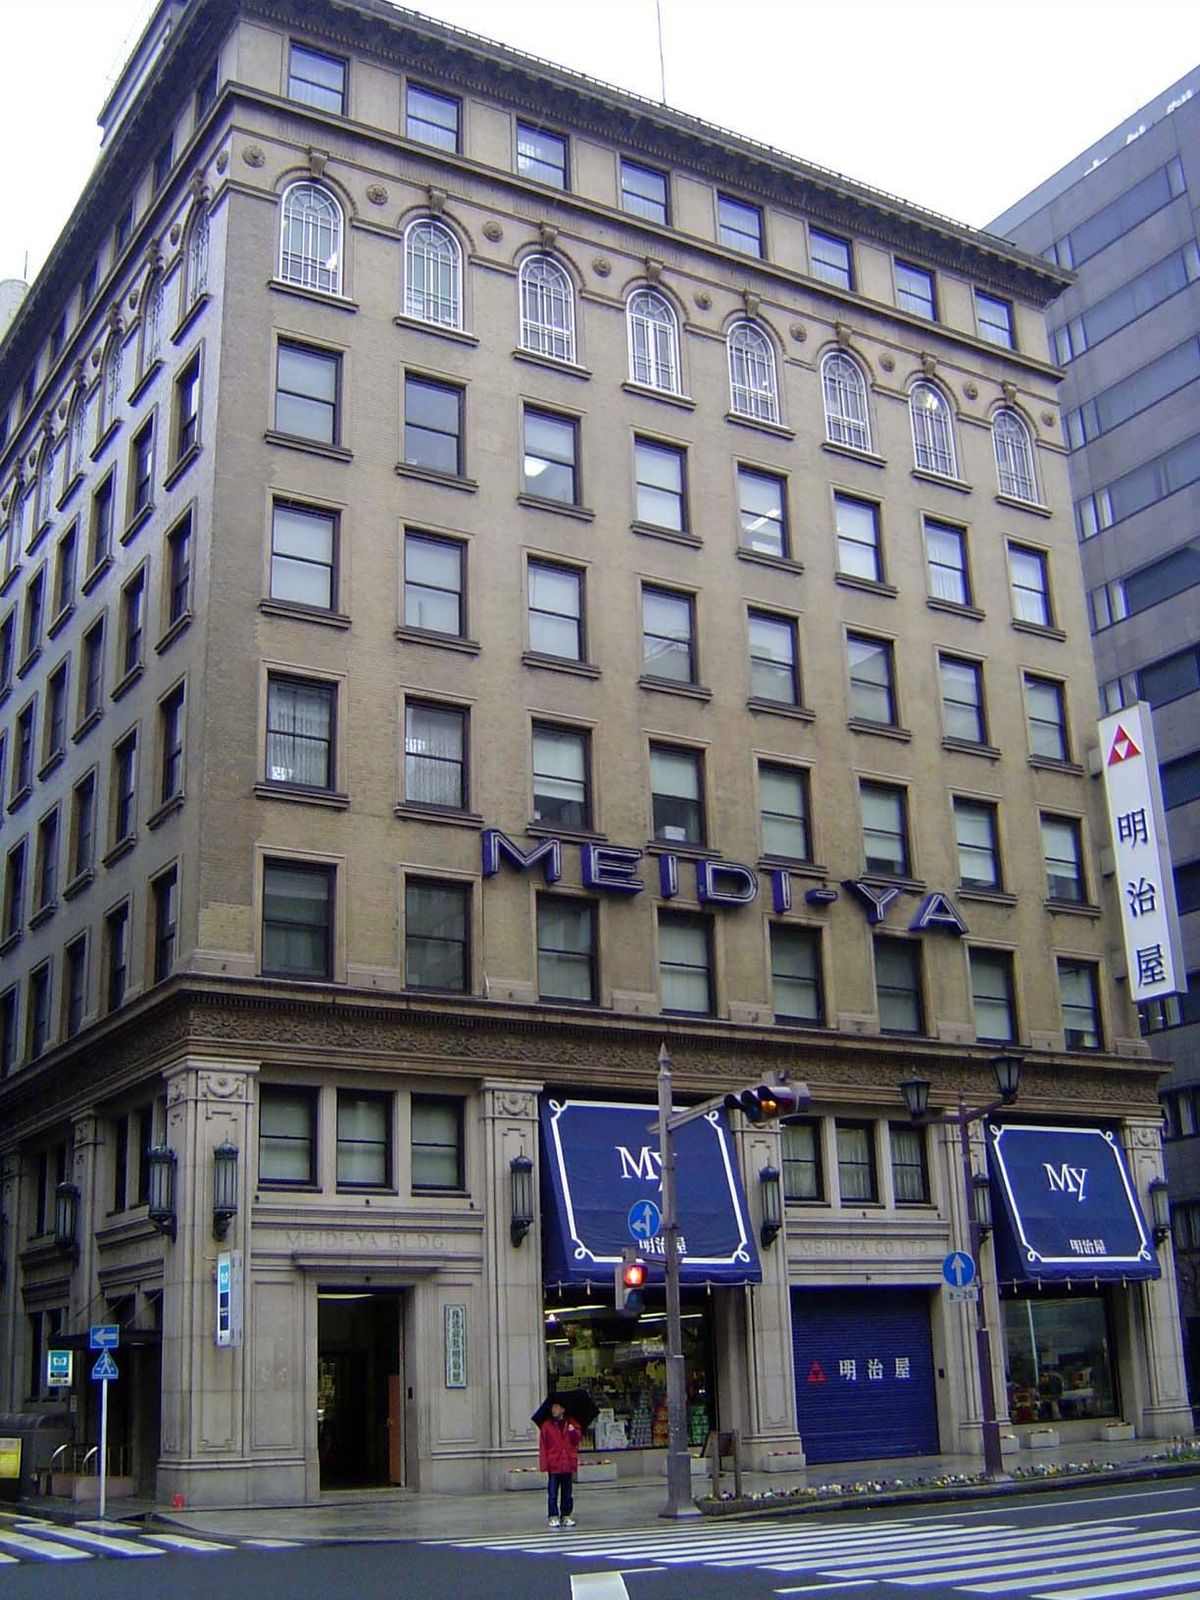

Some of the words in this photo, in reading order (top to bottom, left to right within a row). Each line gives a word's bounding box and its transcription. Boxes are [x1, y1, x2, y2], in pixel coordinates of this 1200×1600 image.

[481, 828, 969, 935] MEIDI-YA
[1117, 808, 1166, 988] 明治屋
[1069, 1239, 1107, 1254] 明治屋
[838, 1357, 910, 1380] 明治屋
